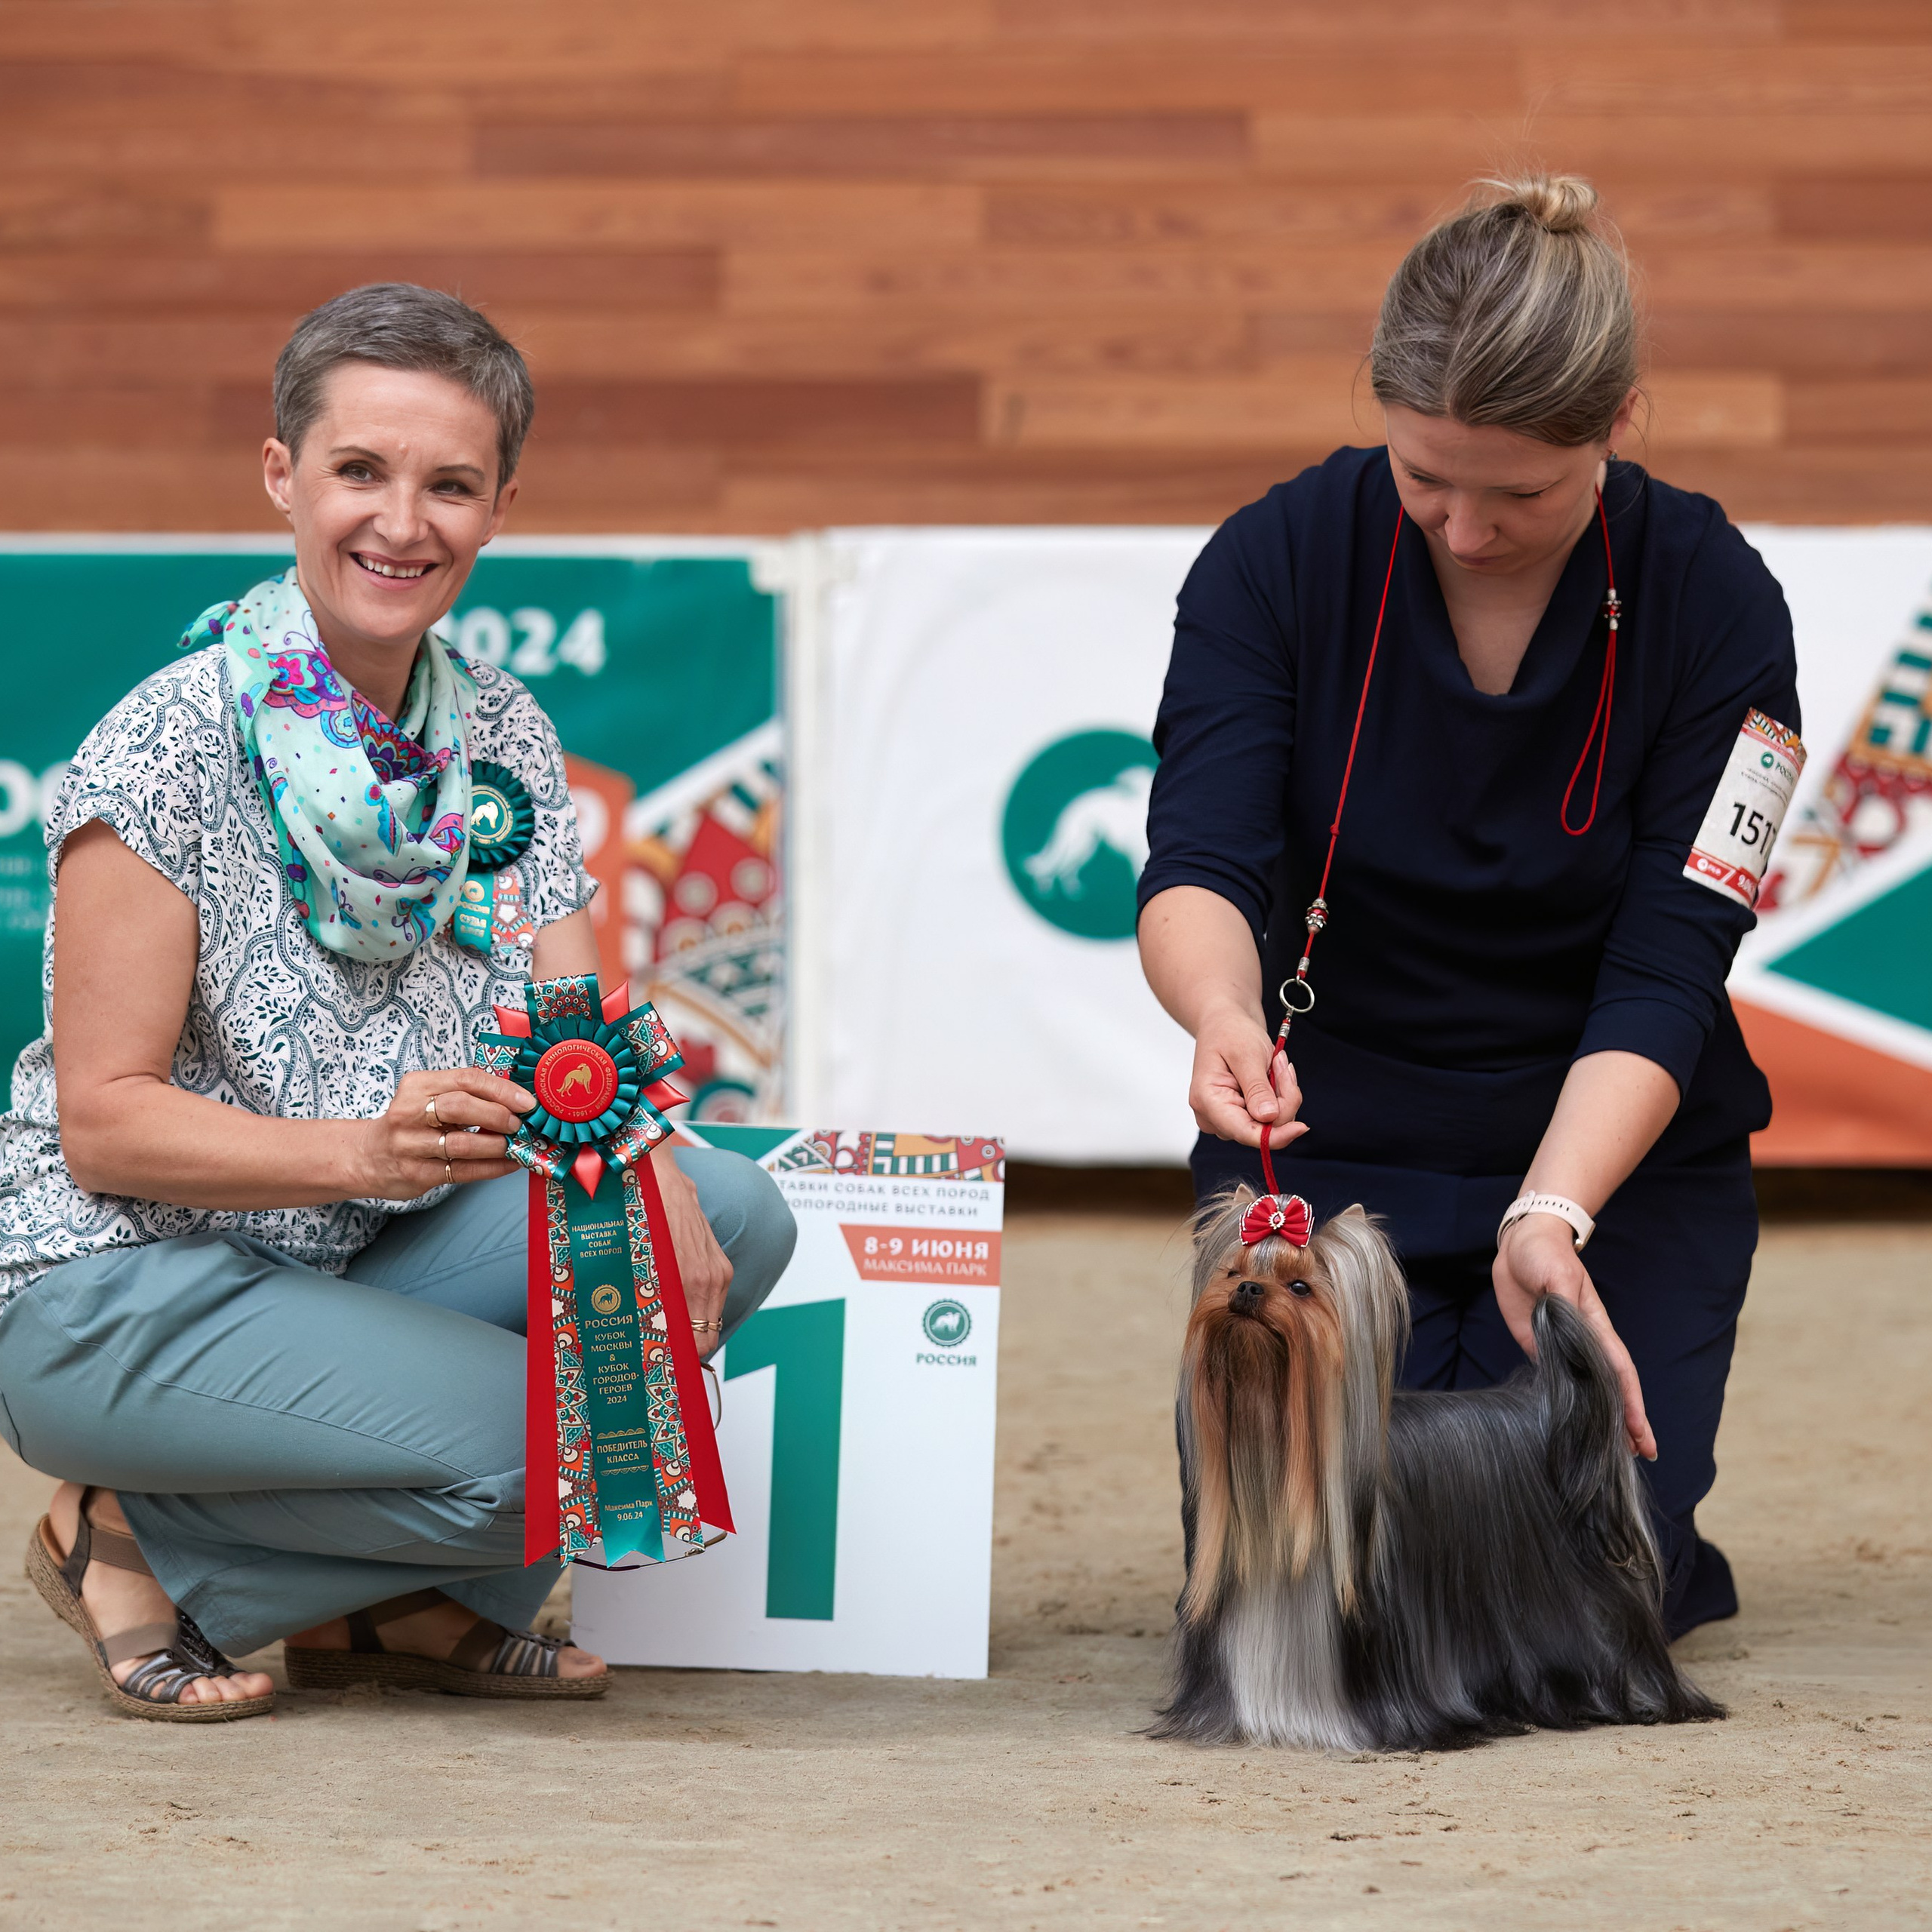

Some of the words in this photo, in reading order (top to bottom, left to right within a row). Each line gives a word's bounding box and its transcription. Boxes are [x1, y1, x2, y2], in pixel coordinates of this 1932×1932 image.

[545, 1044, 608, 1066] КИНОЛОГИЧЕСКАЯ
[540, 1068, 565, 1114] РОССИЙСКАЯ
[595, 1067, 613, 1109] ФЕДЕРАЦИЯ
[834, 1182, 886, 1195] СОБАК
[892, 1186, 931, 1197] ВСЕХ
[937, 1187, 990, 1201] ПОРОД
[896, 1203, 978, 1217] ВЫСТАВКИ
[572, 1220, 624, 1232] НАЦИОНАЛЬНАЯ
[581, 1230, 617, 1240] ВЫСТАВКА
[599, 1247, 622, 1255] ПОРОД
[864, 1236, 904, 1256] 8-9
[912, 1238, 989, 1260] ИЮНЯ
[863, 1259, 943, 1275] МАКСИМА
[946, 1263, 987, 1276] ПАРК
[585, 1315, 632, 1329] РОССИЯ
[595, 1331, 626, 1341] КУБОК
[591, 1341, 632, 1352] МОСКВЫ
[916, 1353, 977, 1366] РОССИЯ
[598, 1363, 629, 1374] КУБОК
[599, 1384, 632, 1395] ГЕРОЕВ
[607, 1395, 627, 1404] 2024
[597, 1440, 648, 1454] ПОБЕДИТЕЛЬ
[607, 1454, 639, 1463] КЛАССА
[724, 1297, 846, 1620] 1
[605, 1502, 635, 1511] Максима
[635, 1500, 653, 1509] Парк
[617, 1511, 643, 1521] 9.06.24
